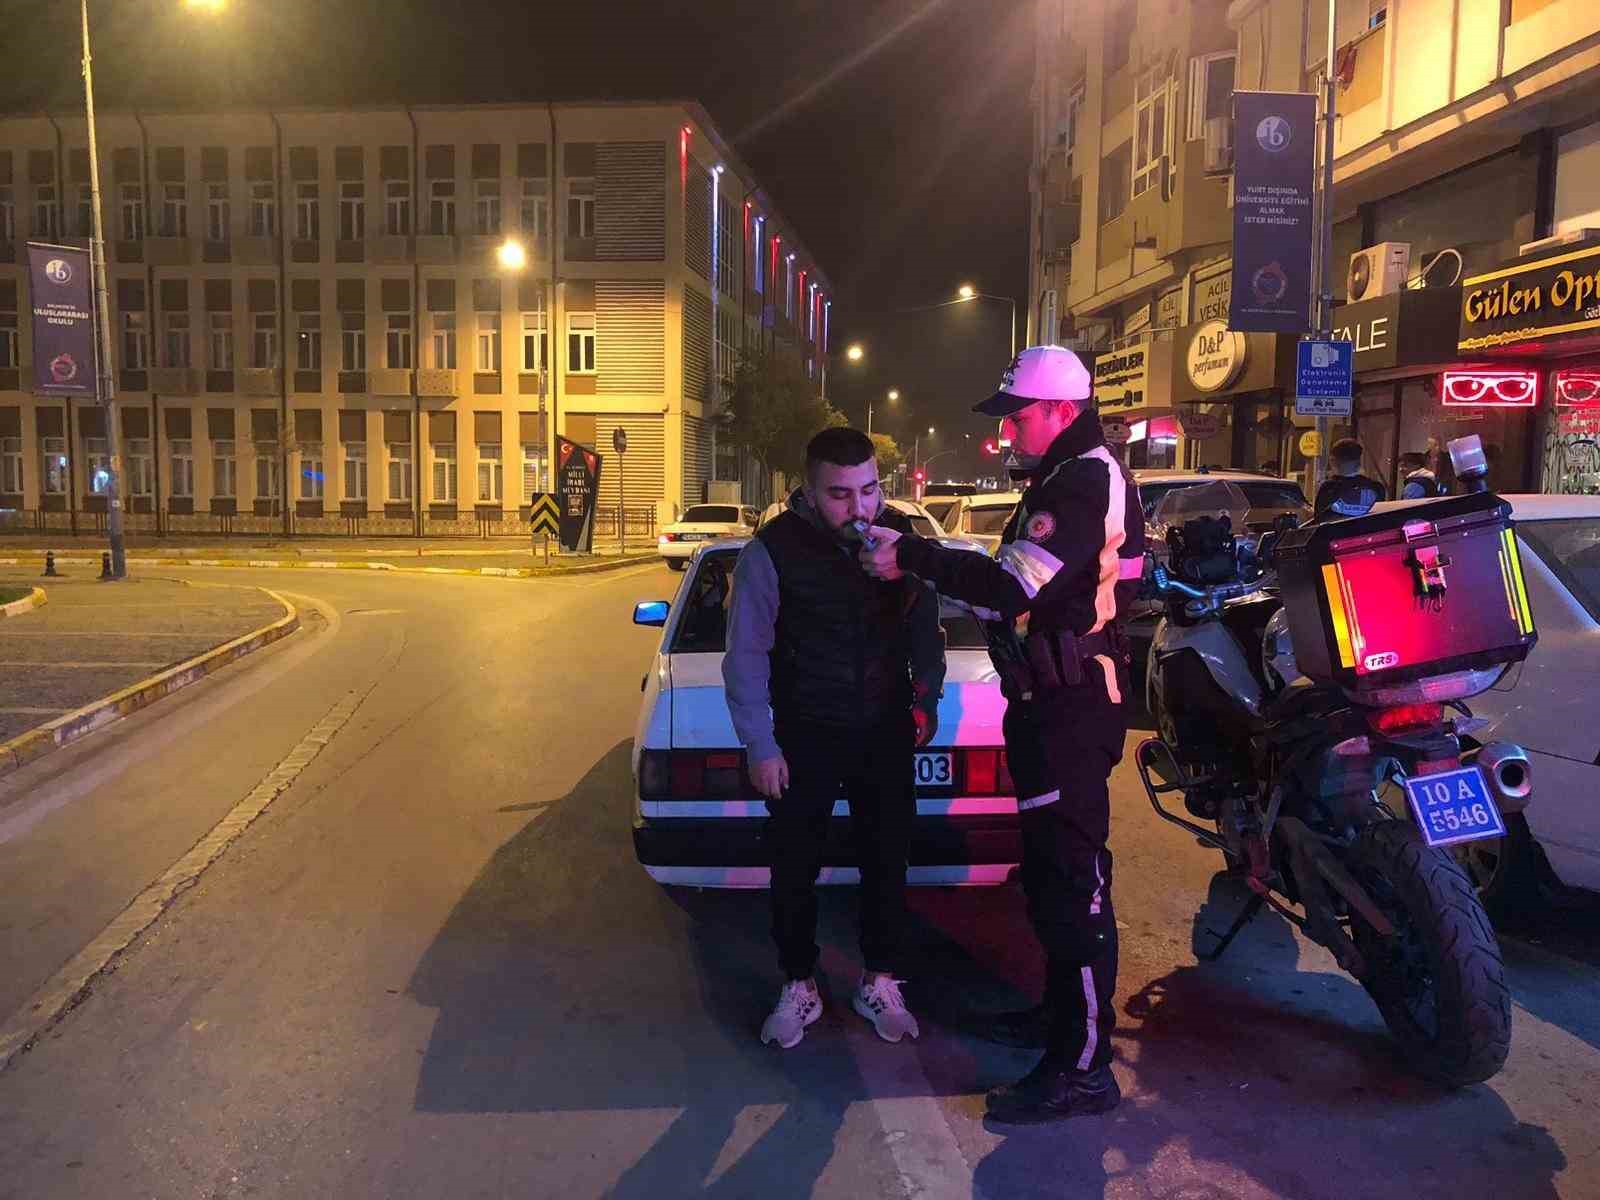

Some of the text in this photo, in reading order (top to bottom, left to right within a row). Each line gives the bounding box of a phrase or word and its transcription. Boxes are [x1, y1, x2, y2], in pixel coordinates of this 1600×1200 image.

[1200, 298, 1231, 321] VESİK
[1465, 281, 1541, 322] Gülen
[1199, 330, 1224, 356] D&P
[1370, 655, 1392, 667] TRS
[1421, 779, 1476, 806] 10 A
[1429, 803, 1489, 833] 5546
